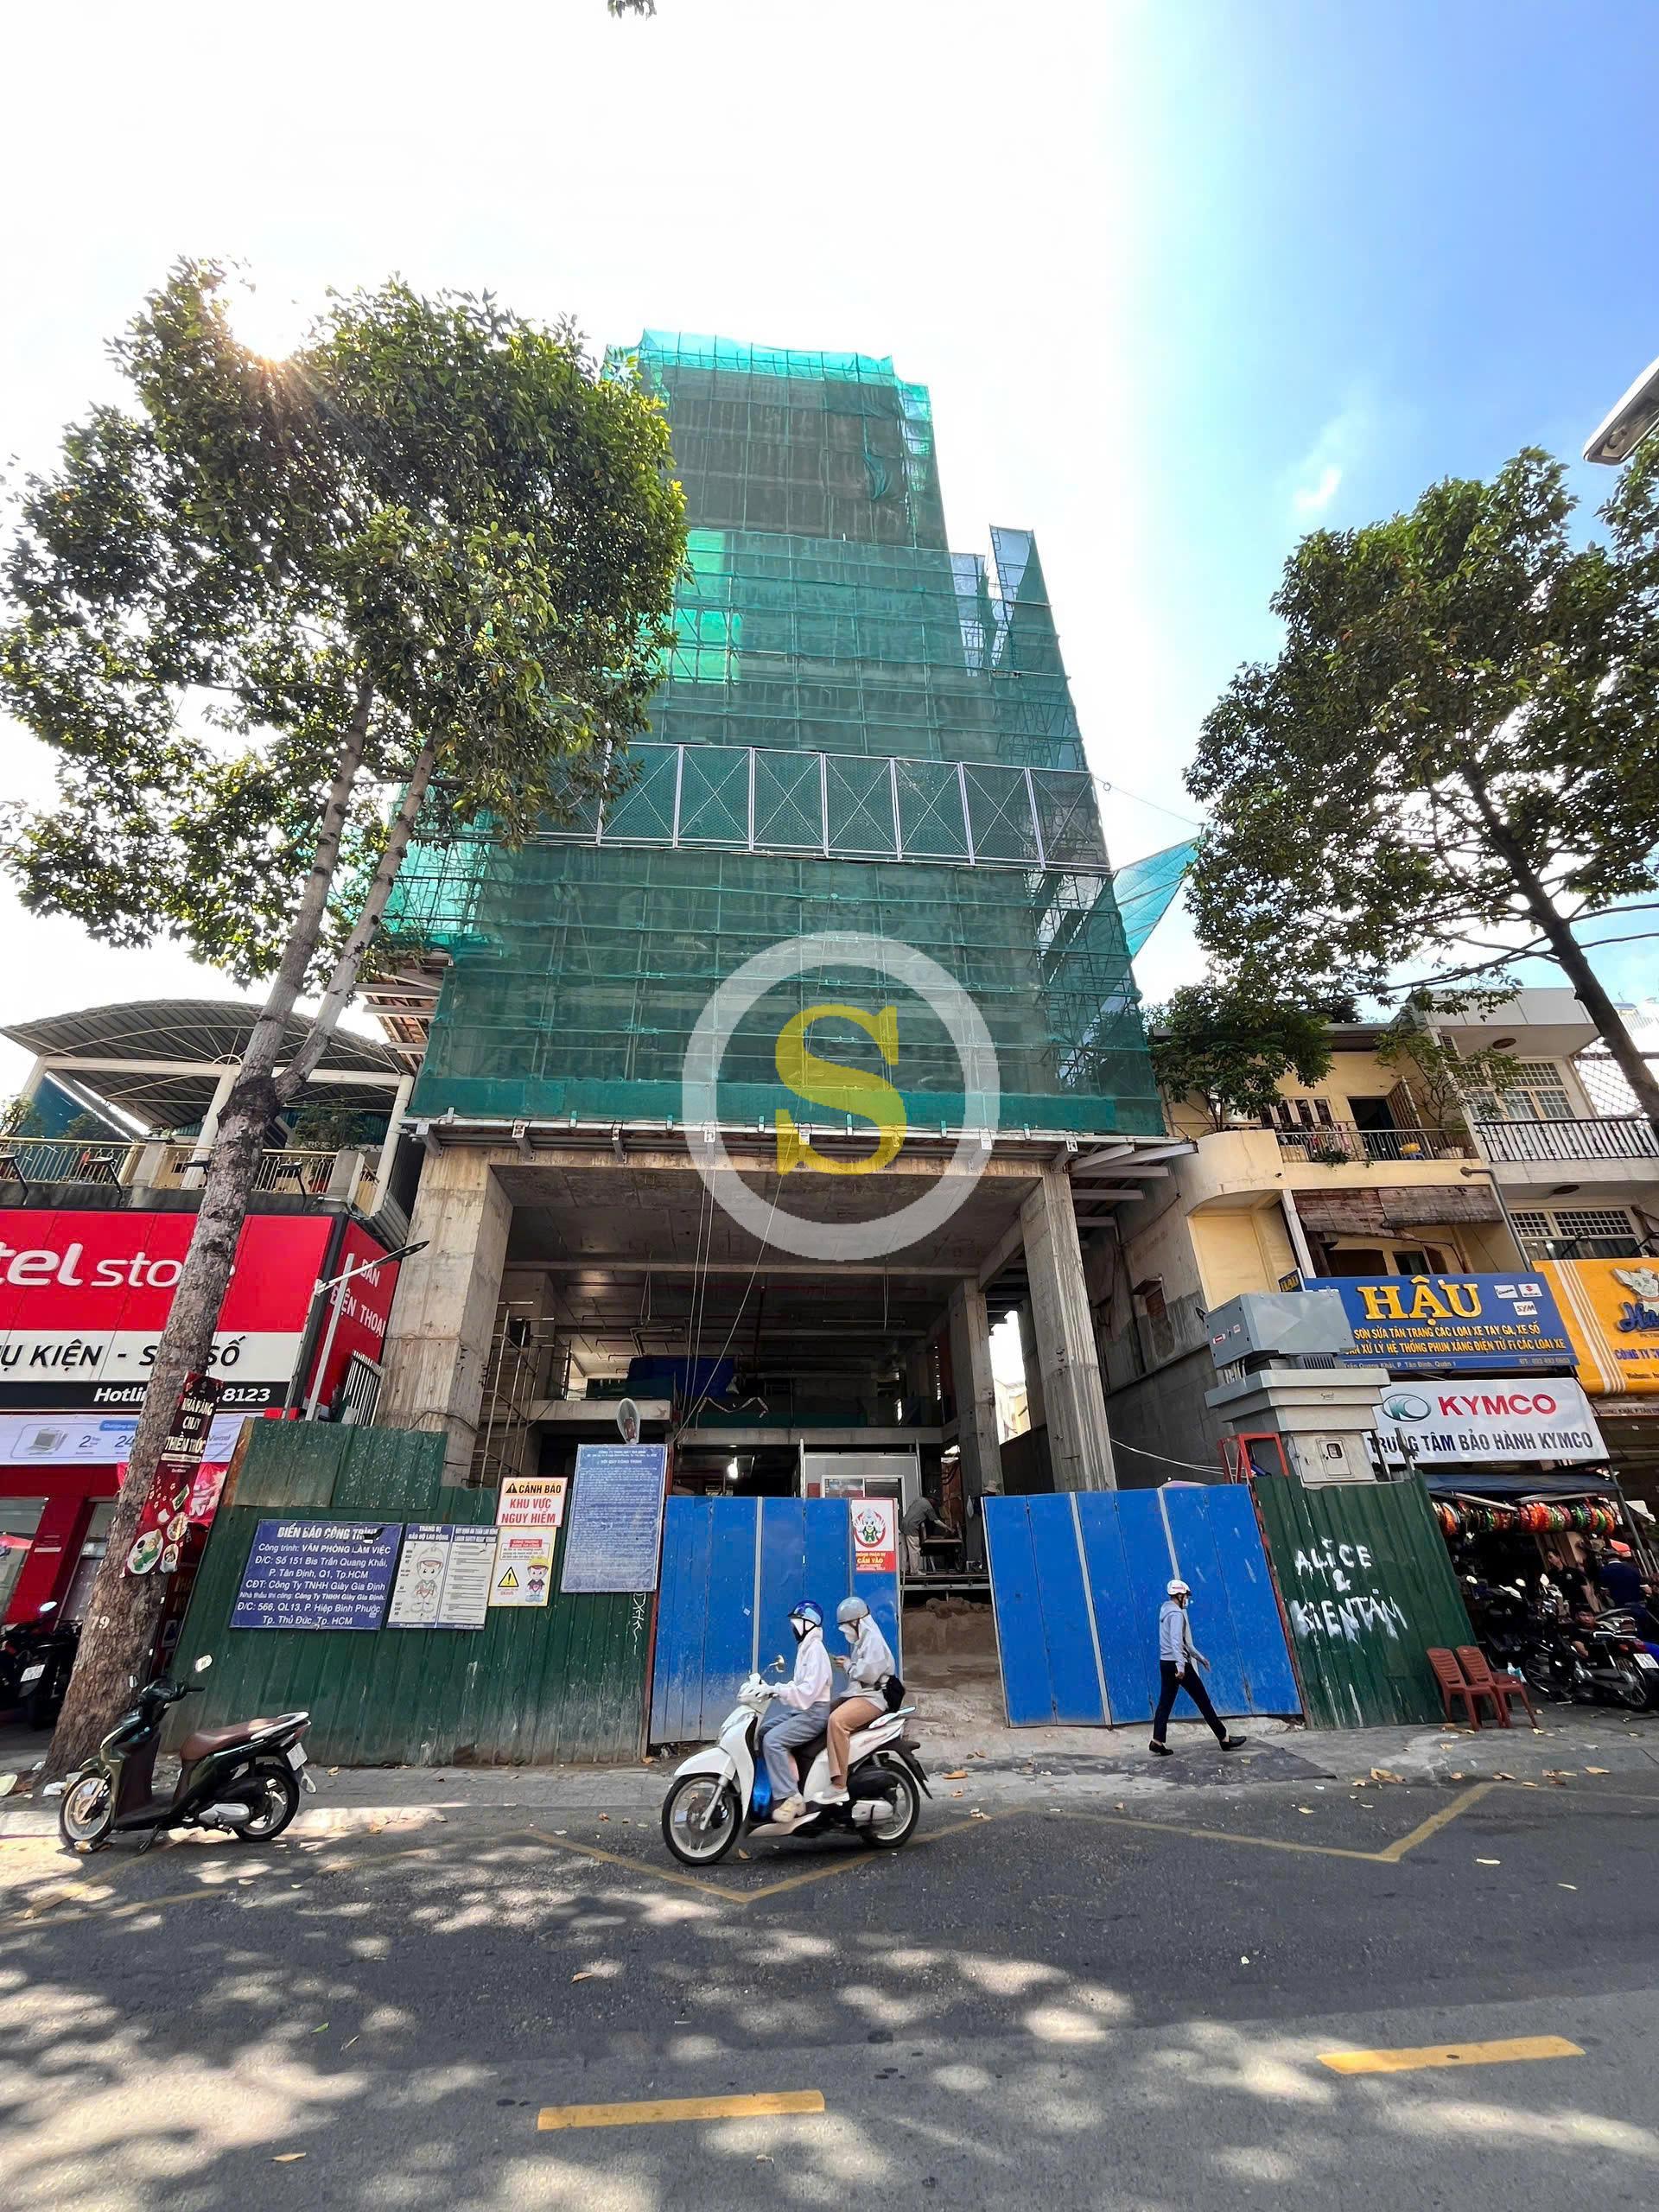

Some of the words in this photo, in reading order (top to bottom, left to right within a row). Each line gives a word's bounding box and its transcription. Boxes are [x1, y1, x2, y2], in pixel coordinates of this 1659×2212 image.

[91, 1251, 235, 1287] sto
[1357, 1275, 1484, 1326] HẬU
[1516, 1304, 1535, 1313] SYM
[359, 1304, 387, 1338] THOẠI
[1389, 1326, 1407, 1338] TÂN
[1407, 1326, 1434, 1338] TRANG
[1434, 1325, 1452, 1338] CÁC
[1452, 1325, 1471, 1338] LOẠI
[1471, 1325, 1484, 1336] XE
[1483, 1325, 1501, 1336] TAY
[1516, 1324, 1529, 1335] XE
[1400, 1339, 1427, 1354] THỐNG
[1427, 1342, 1452, 1353] PHUN
[1451, 1339, 1472, 1353] XĂNG
[1473, 1338, 1495, 1354] ĐIỆN
[1516, 1338, 1535, 1351] CÁC
[1535, 1338, 1554, 1352] LOẠI
[1554, 1338, 1567, 1349] XE
[29, 1338, 103, 1371] KIỆN
[93, 1388, 148, 1402] Hotli
[1438, 1393, 1557, 1416] KYMCO
[1367, 1434, 1419, 1454] TRUG
[1421, 1431, 1457, 1452] TÂM
[1458, 1428, 1491, 1452] BẢO
[1492, 1429, 1537, 1451] HÀNH
[1537, 1431, 1594, 1451] KYMCO
[518, 1482, 542, 1494] CẢNH
[543, 1483, 562, 1494] BÁO
[510, 1498, 530, 1510] KHU
[532, 1497, 551, 1511] VỰC
[501, 1513, 531, 1523] NGUY
[531, 1509, 556, 1523] HIỂM
[323, 1526, 350, 1540] CÔNG
[258, 1543, 278, 1554] Công
[302, 1543, 320, 1554] VĂN
[321, 1544, 350, 1554] PHÒNG
[353, 1545, 370, 1554] LÀM
[372, 1545, 391, 1555] VIỆC
[255, 1556, 274, 1565] Đ/C:
[275, 1555, 287, 1565] Số
[305, 1557, 318, 1566] Bis
[321, 1557, 338, 1566] Trần
[340, 1558, 366, 1567] Quang
[296, 1569, 316, 1579] Định,
[319, 1570, 333, 1579] Q1,
[336, 1571, 369, 1580] Tp.HCM
[245, 1580, 266, 1588] CĐT:
[268, 1580, 290, 1590] Công
[292, 1580, 303, 1590] Ty
[304, 1580, 329, 1590] TNHH
[330, 1581, 348, 1591] Giày
[366, 1582, 385, 1592] Định
[237, 1602, 256, 1611] Đ/C:
[257, 1603, 275, 1611] 566,
[277, 1603, 302, 1611] QL13,
[314, 1604, 333, 1613] Hiệp
[334, 1604, 353, 1612] Bình
[263, 1616, 275, 1624] Tp.
[278, 1614, 294, 1624] Thủ
[332, 1617, 353, 1625] HCM
